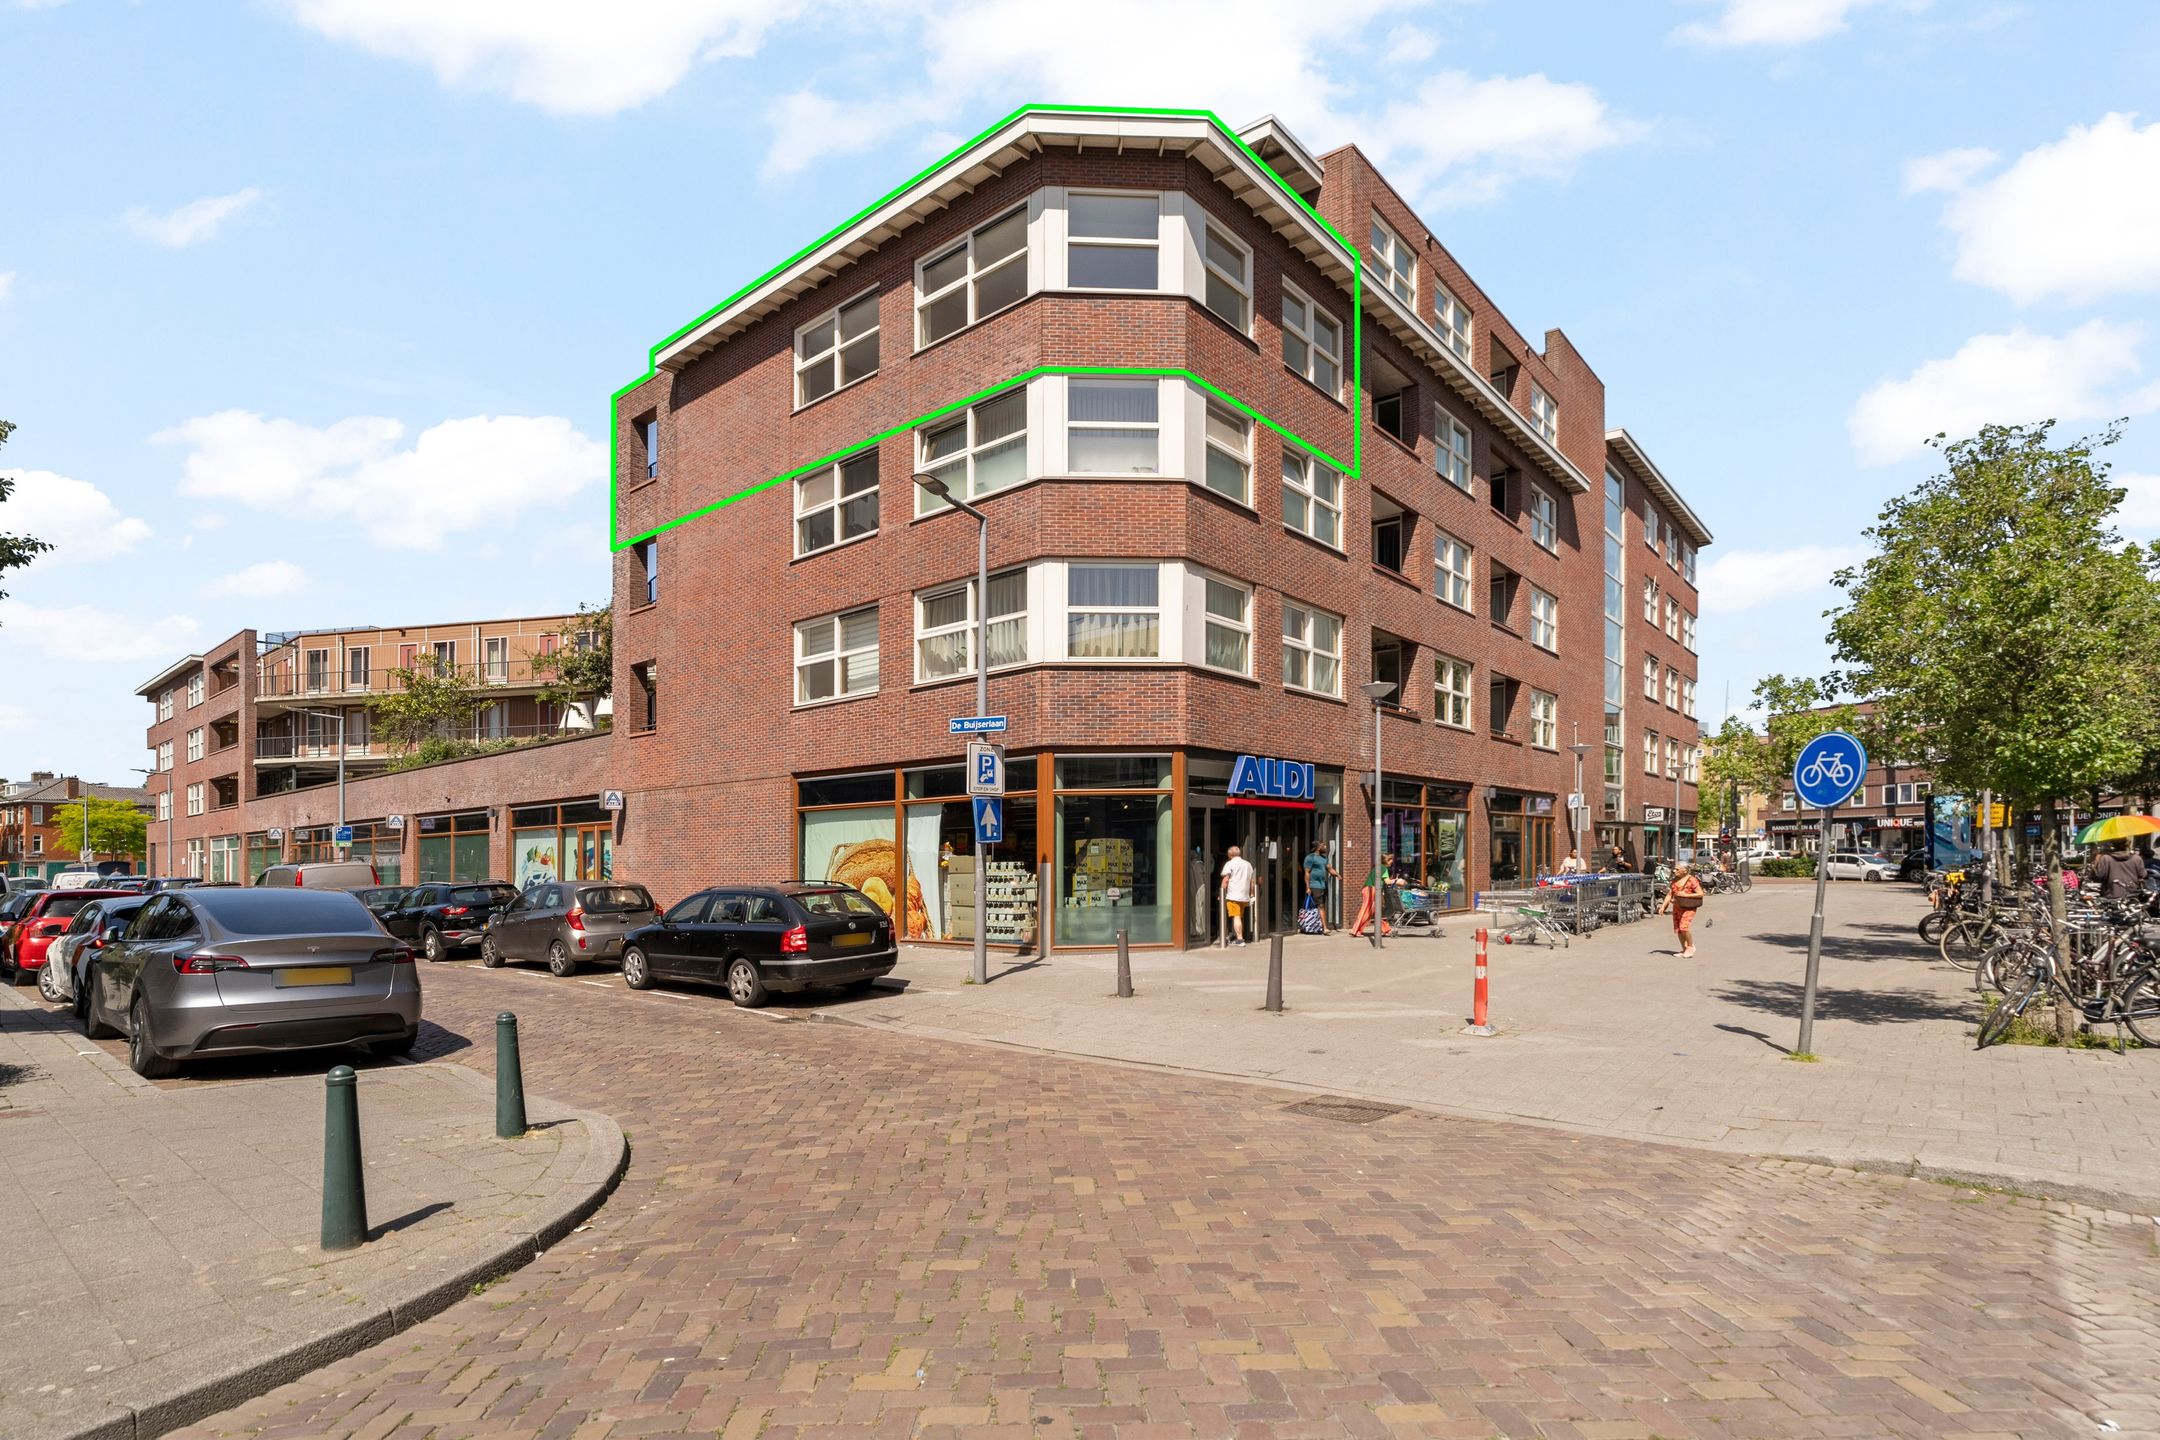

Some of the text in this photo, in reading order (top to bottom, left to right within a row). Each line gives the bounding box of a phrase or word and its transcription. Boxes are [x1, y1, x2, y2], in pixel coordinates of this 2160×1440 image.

[951, 720, 1004, 730] De Buijserlaan
[982, 756, 992, 772] P
[1227, 755, 1315, 799] ALDI
[1877, 818, 1914, 828] UNIQUE
